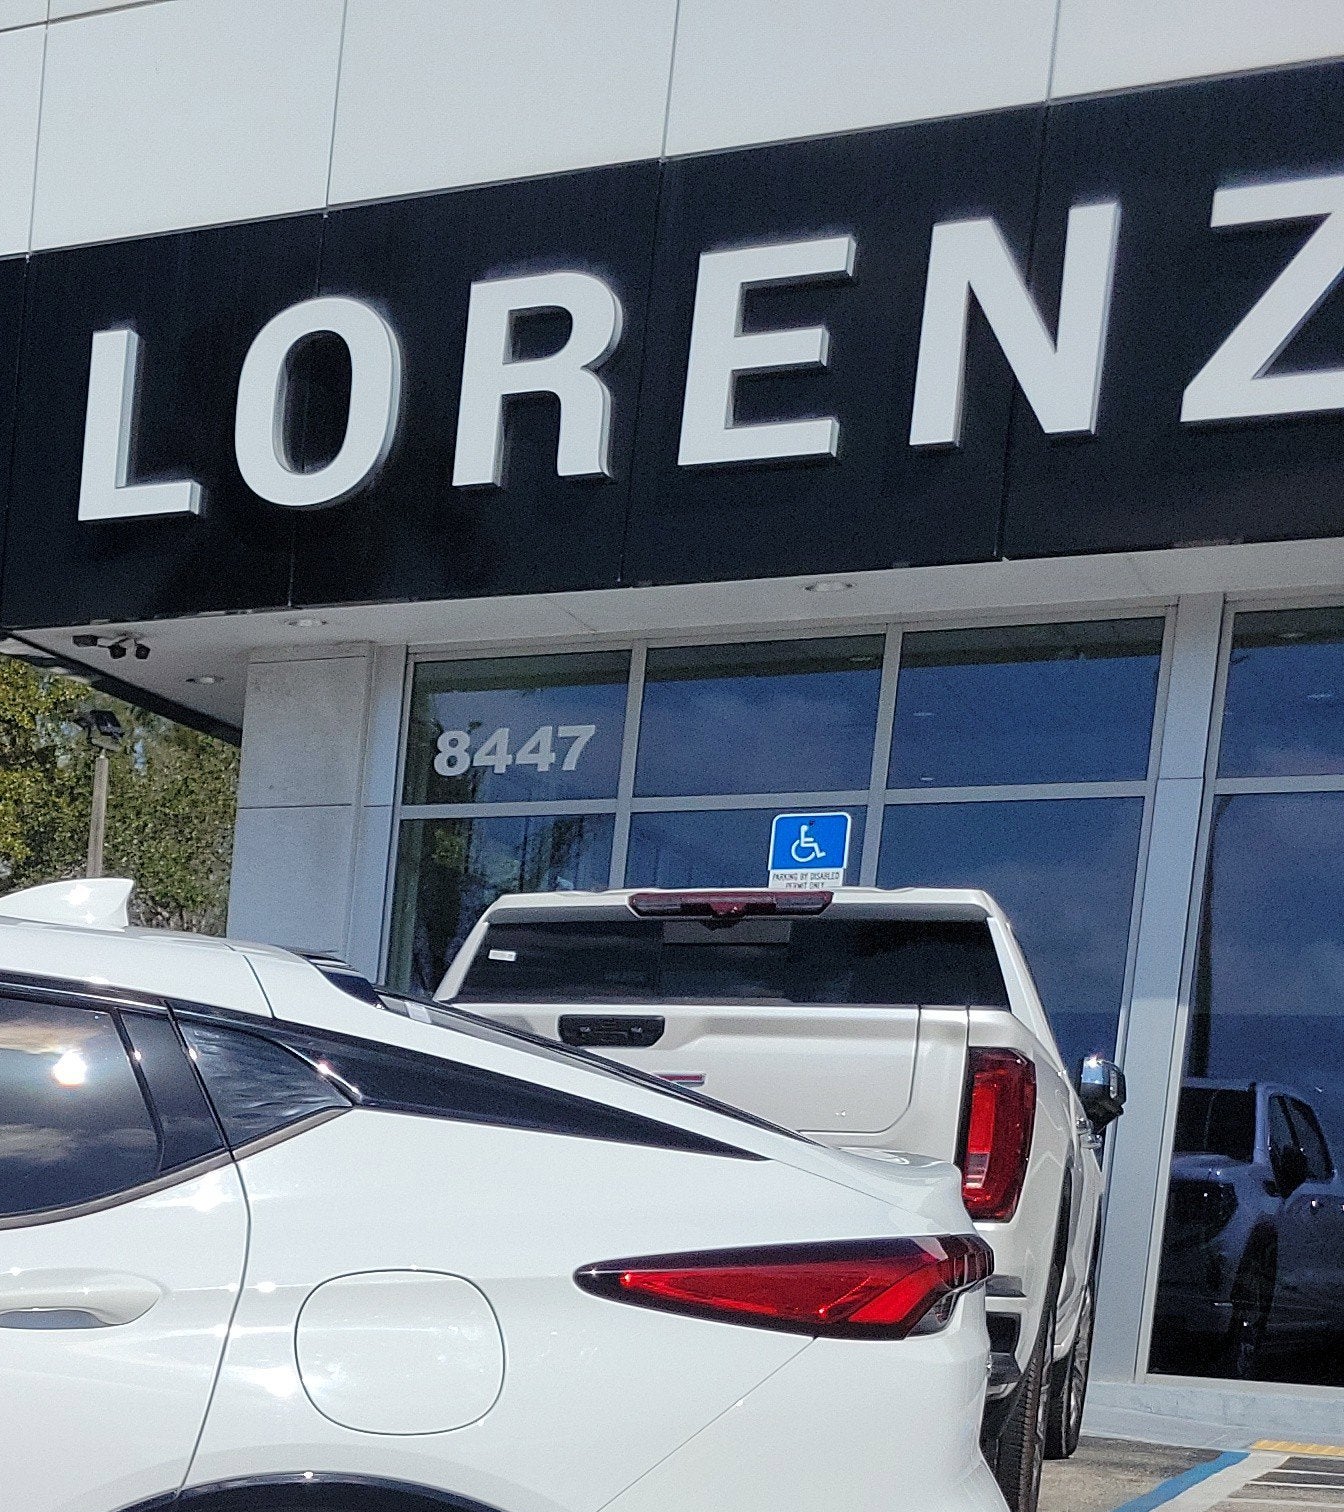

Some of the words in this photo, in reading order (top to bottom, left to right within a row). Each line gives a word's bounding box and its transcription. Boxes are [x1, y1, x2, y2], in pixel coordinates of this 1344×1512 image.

[77, 174, 1344, 521] LORENZ
[432, 724, 596, 777] 8447
[810, 871, 840, 880] DISABLED
